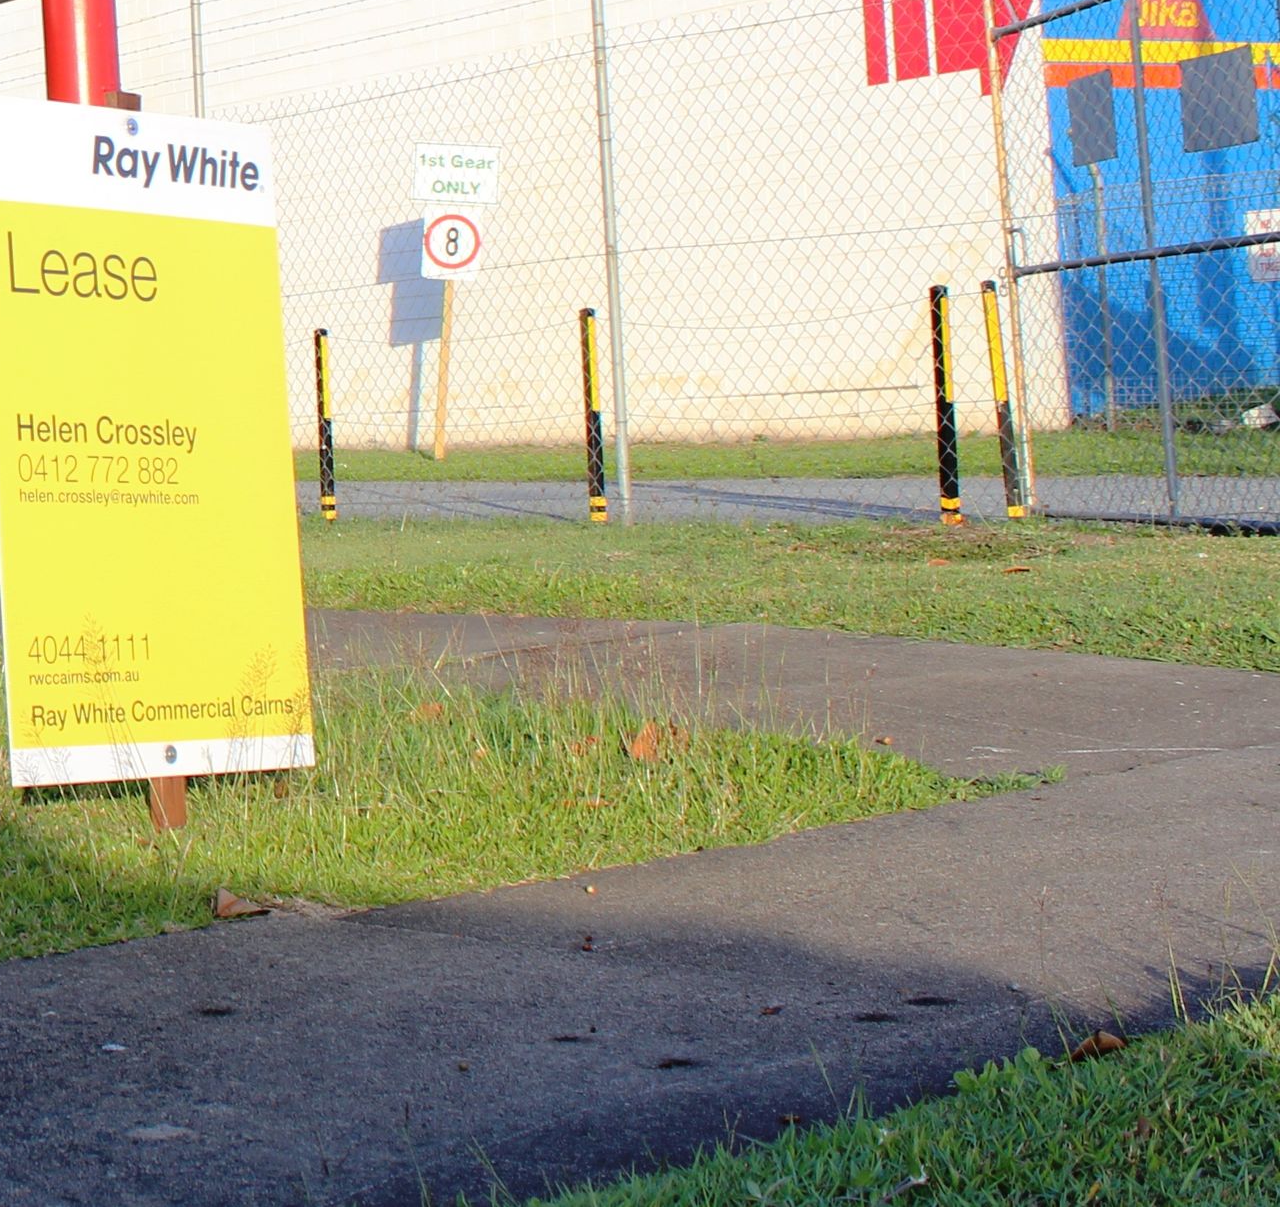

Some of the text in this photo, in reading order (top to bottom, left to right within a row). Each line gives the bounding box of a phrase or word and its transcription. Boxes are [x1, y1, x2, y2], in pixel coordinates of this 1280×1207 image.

[92, 135, 260, 192] Ray White
[420, 154, 496, 169] 1st Gear
[432, 180, 481, 194] ONLY
[445, 227, 459, 257] 8
[7, 231, 158, 302] Lease
[16, 413, 198, 455] Helen Crossley
[18, 453, 180, 485] 0412 772 882
[19, 488, 200, 508] helen.crossley@raywhite.com
[28, 632, 151, 665] 4044 1111
[29, 669, 140, 686] rwccairns.com.au
[31, 694, 294, 732] Ray White Commercial Cairns
